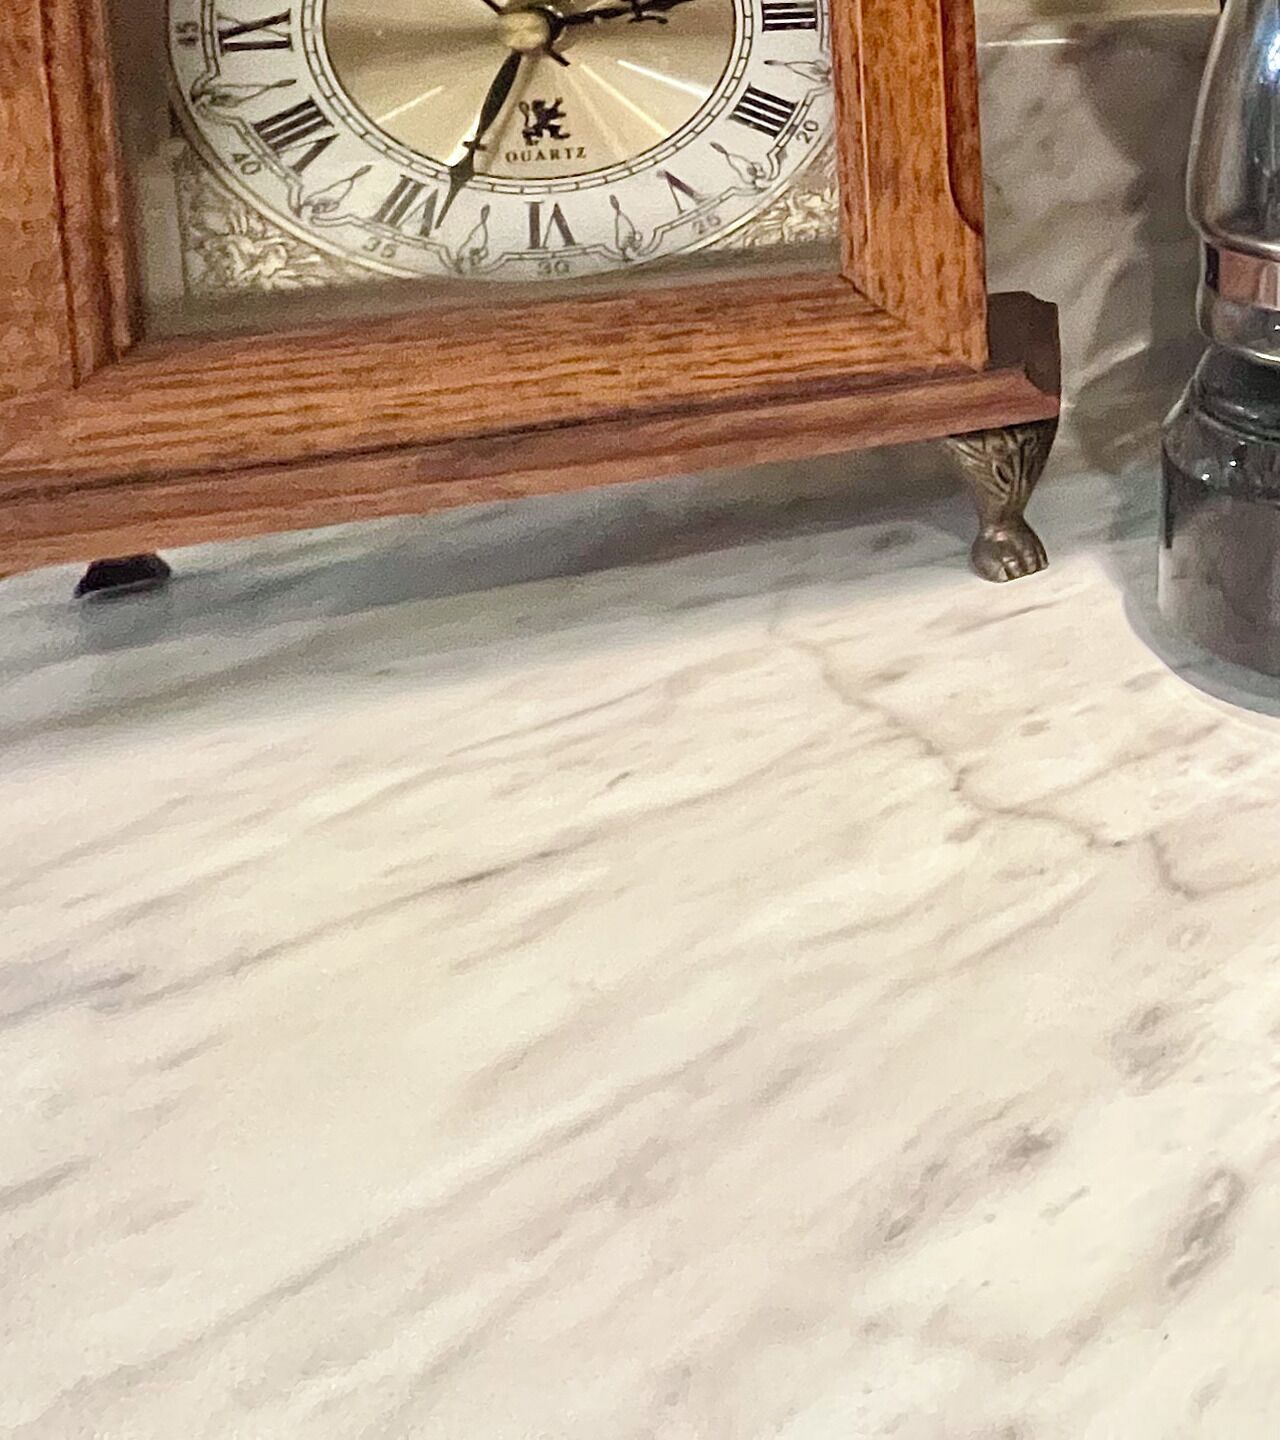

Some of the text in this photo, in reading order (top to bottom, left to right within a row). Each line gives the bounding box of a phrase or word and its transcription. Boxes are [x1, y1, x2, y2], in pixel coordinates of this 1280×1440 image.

[217, 8, 294, 54] IX
[761, 0, 818, 32] III
[727, 82, 800, 139] IIII
[251, 96, 340, 175] VIII
[796, 119, 820, 144] 20
[233, 153, 262, 175] 40
[505, 146, 586, 163] QUARTZ
[524, 201, 580, 250] VI
[362, 237, 396, 259] 35
